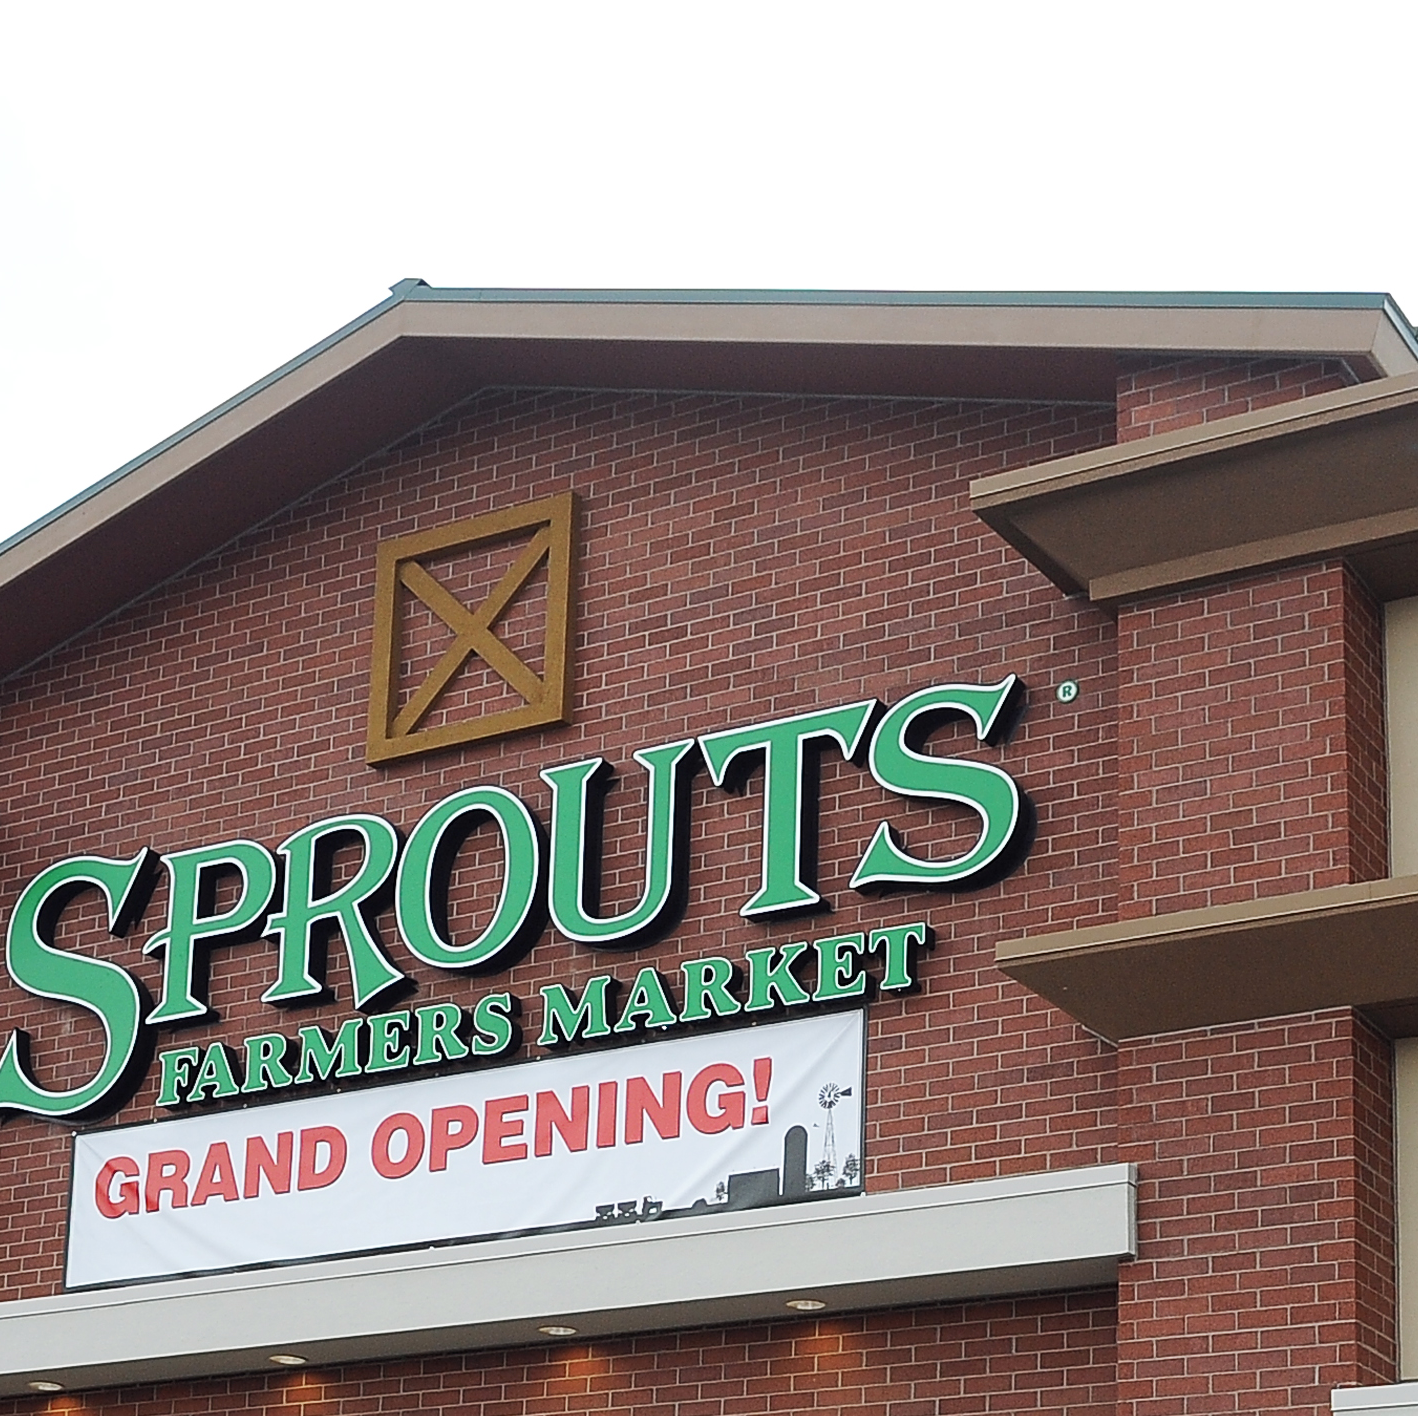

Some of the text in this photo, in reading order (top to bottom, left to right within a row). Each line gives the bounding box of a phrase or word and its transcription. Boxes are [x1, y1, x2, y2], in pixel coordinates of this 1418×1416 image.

[157, 922, 928, 1108] FARMERS MARKET
[95, 1058, 773, 1220] GRAND OPENING!
